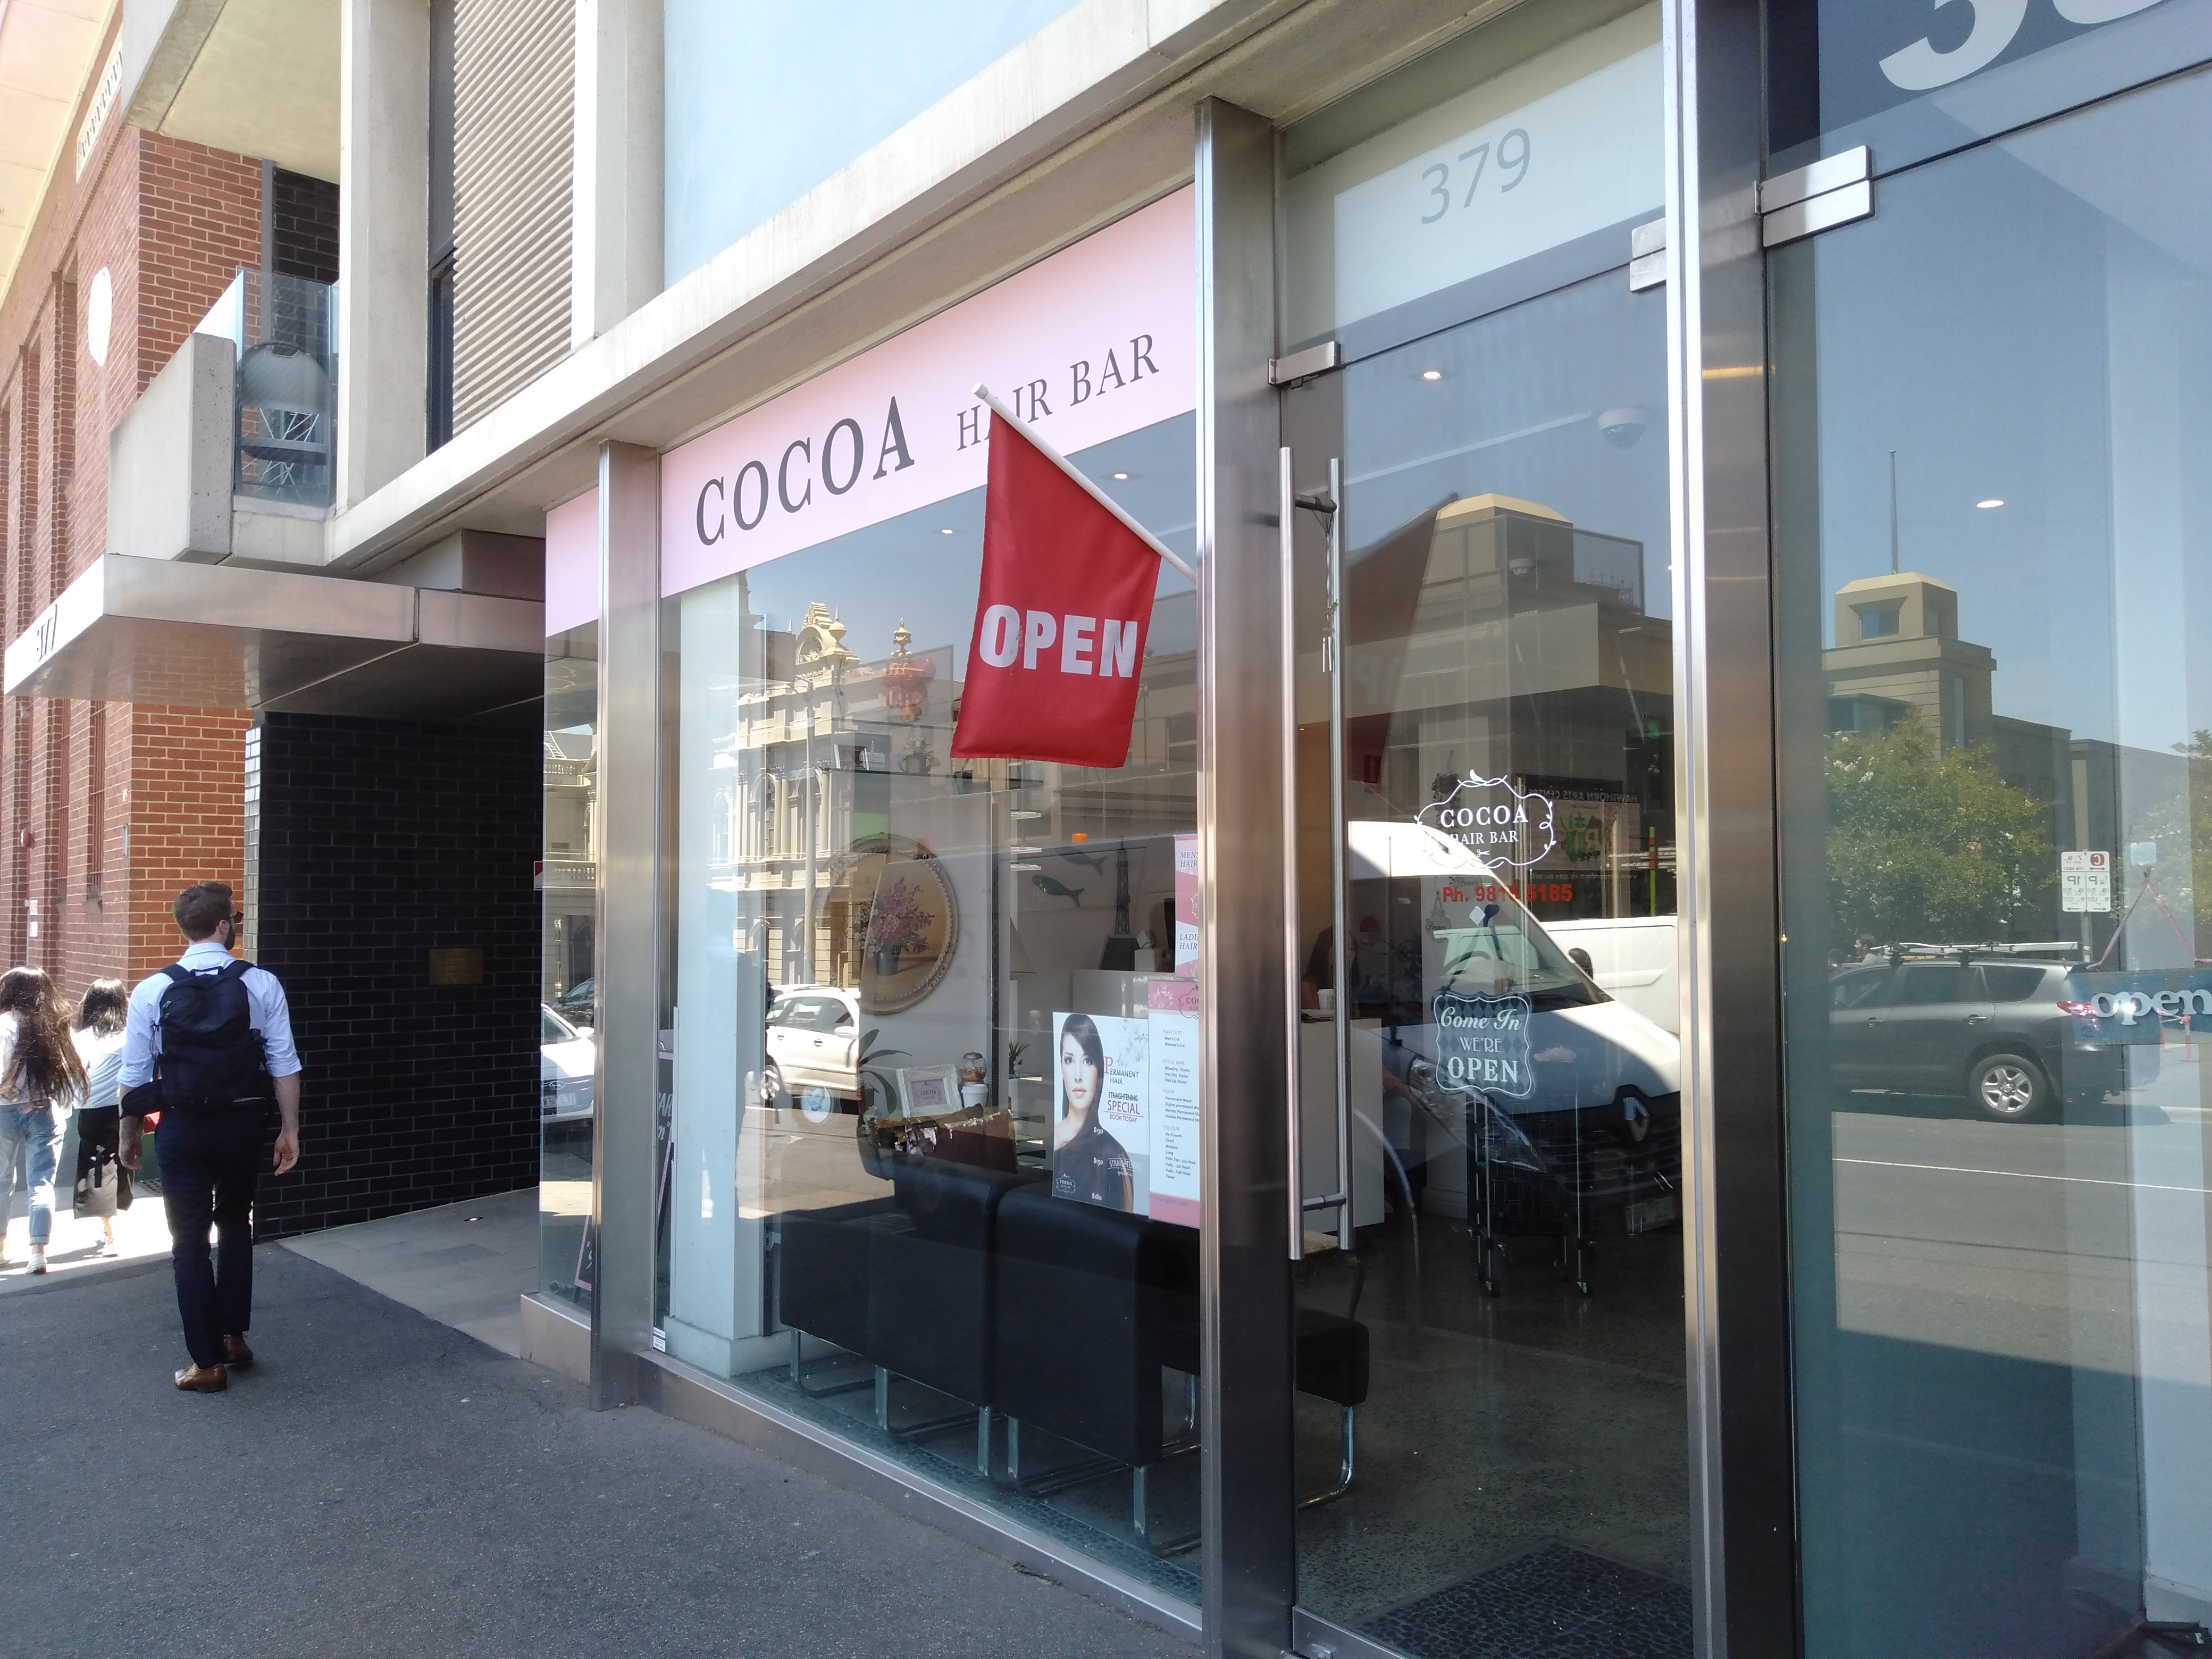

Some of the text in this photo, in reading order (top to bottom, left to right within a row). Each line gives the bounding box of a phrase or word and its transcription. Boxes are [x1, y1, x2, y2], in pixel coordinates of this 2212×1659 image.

[1421, 128, 1531, 224] 379
[696, 334, 1160, 547] COCOA HIR BAR
[979, 604, 1138, 678] OPEN
[1440, 804, 1528, 828] COCOA
[1449, 831, 1519, 845] HAIR BAR
[1443, 884, 1573, 902] Ph. 9818 5185
[2090, 989, 2212, 1026] open
[1440, 1007, 1522, 1031] Come In
[1460, 1037, 1503, 1053] WE'RE
[1447, 1057, 1518, 1083] OPEN
[1108, 1092, 1138, 1101] STRAIGHTENING
[1108, 1100, 1140, 1115] SPECIAL
[1093, 1126, 1103, 1135] $130
[1093, 1157, 1103, 1166] $150
